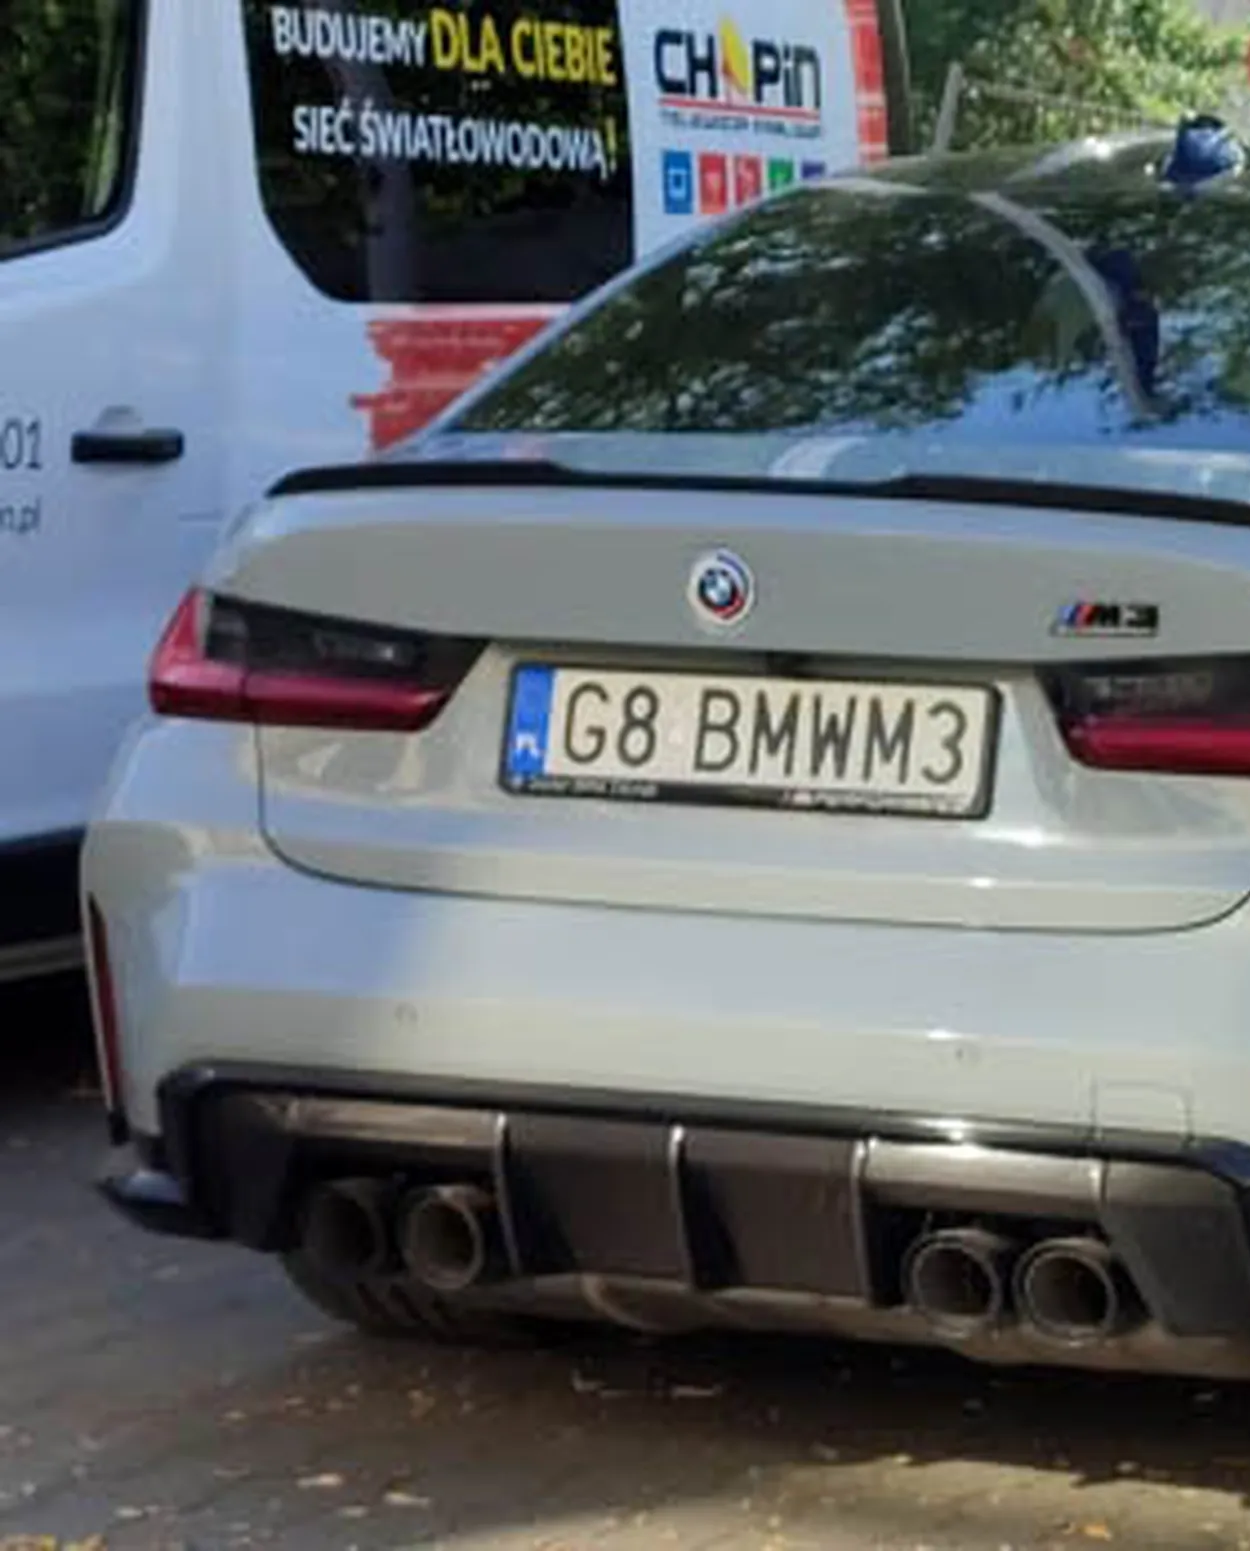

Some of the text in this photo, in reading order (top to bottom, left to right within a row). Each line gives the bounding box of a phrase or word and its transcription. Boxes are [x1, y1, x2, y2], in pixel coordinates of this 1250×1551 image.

[271, 5, 617, 86] BUDUJEMY DLA CIEBIE
[292, 96, 352, 155] SIEĆ
[1080, 601, 1159, 630] M3
[564, 682, 970, 785] G8 BMWM3
